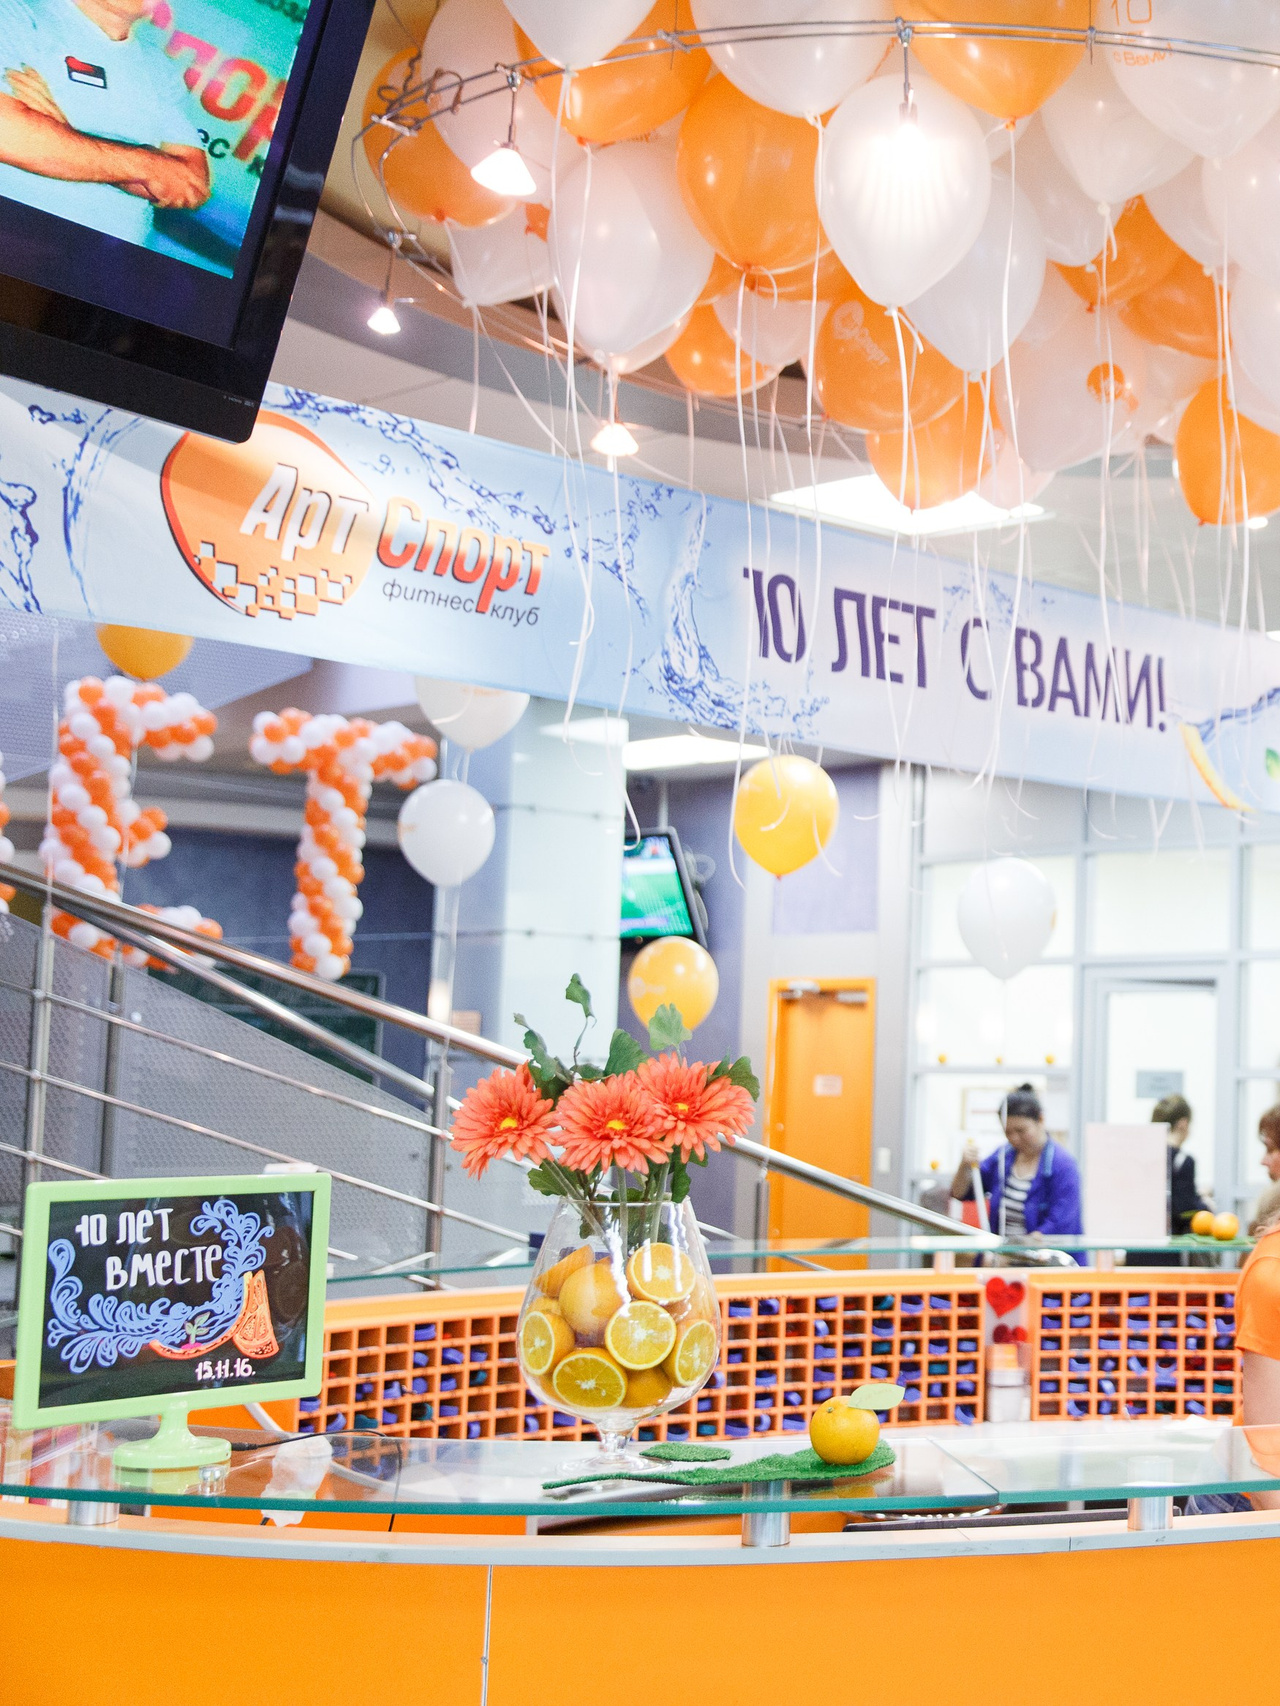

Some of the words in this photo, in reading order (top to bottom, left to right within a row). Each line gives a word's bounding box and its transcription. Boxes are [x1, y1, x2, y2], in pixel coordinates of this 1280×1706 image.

[239, 462, 370, 562] Арт
[376, 496, 550, 614] Спорт
[382, 578, 476, 614] фитнес
[489, 602, 541, 628] клуб
[743, 567, 807, 664] 10
[831, 586, 937, 688] ЛЕТ
[960, 617, 993, 701] С
[1014, 626, 1167, 733] ВАМИ!
[75, 1213, 108, 1247] 10
